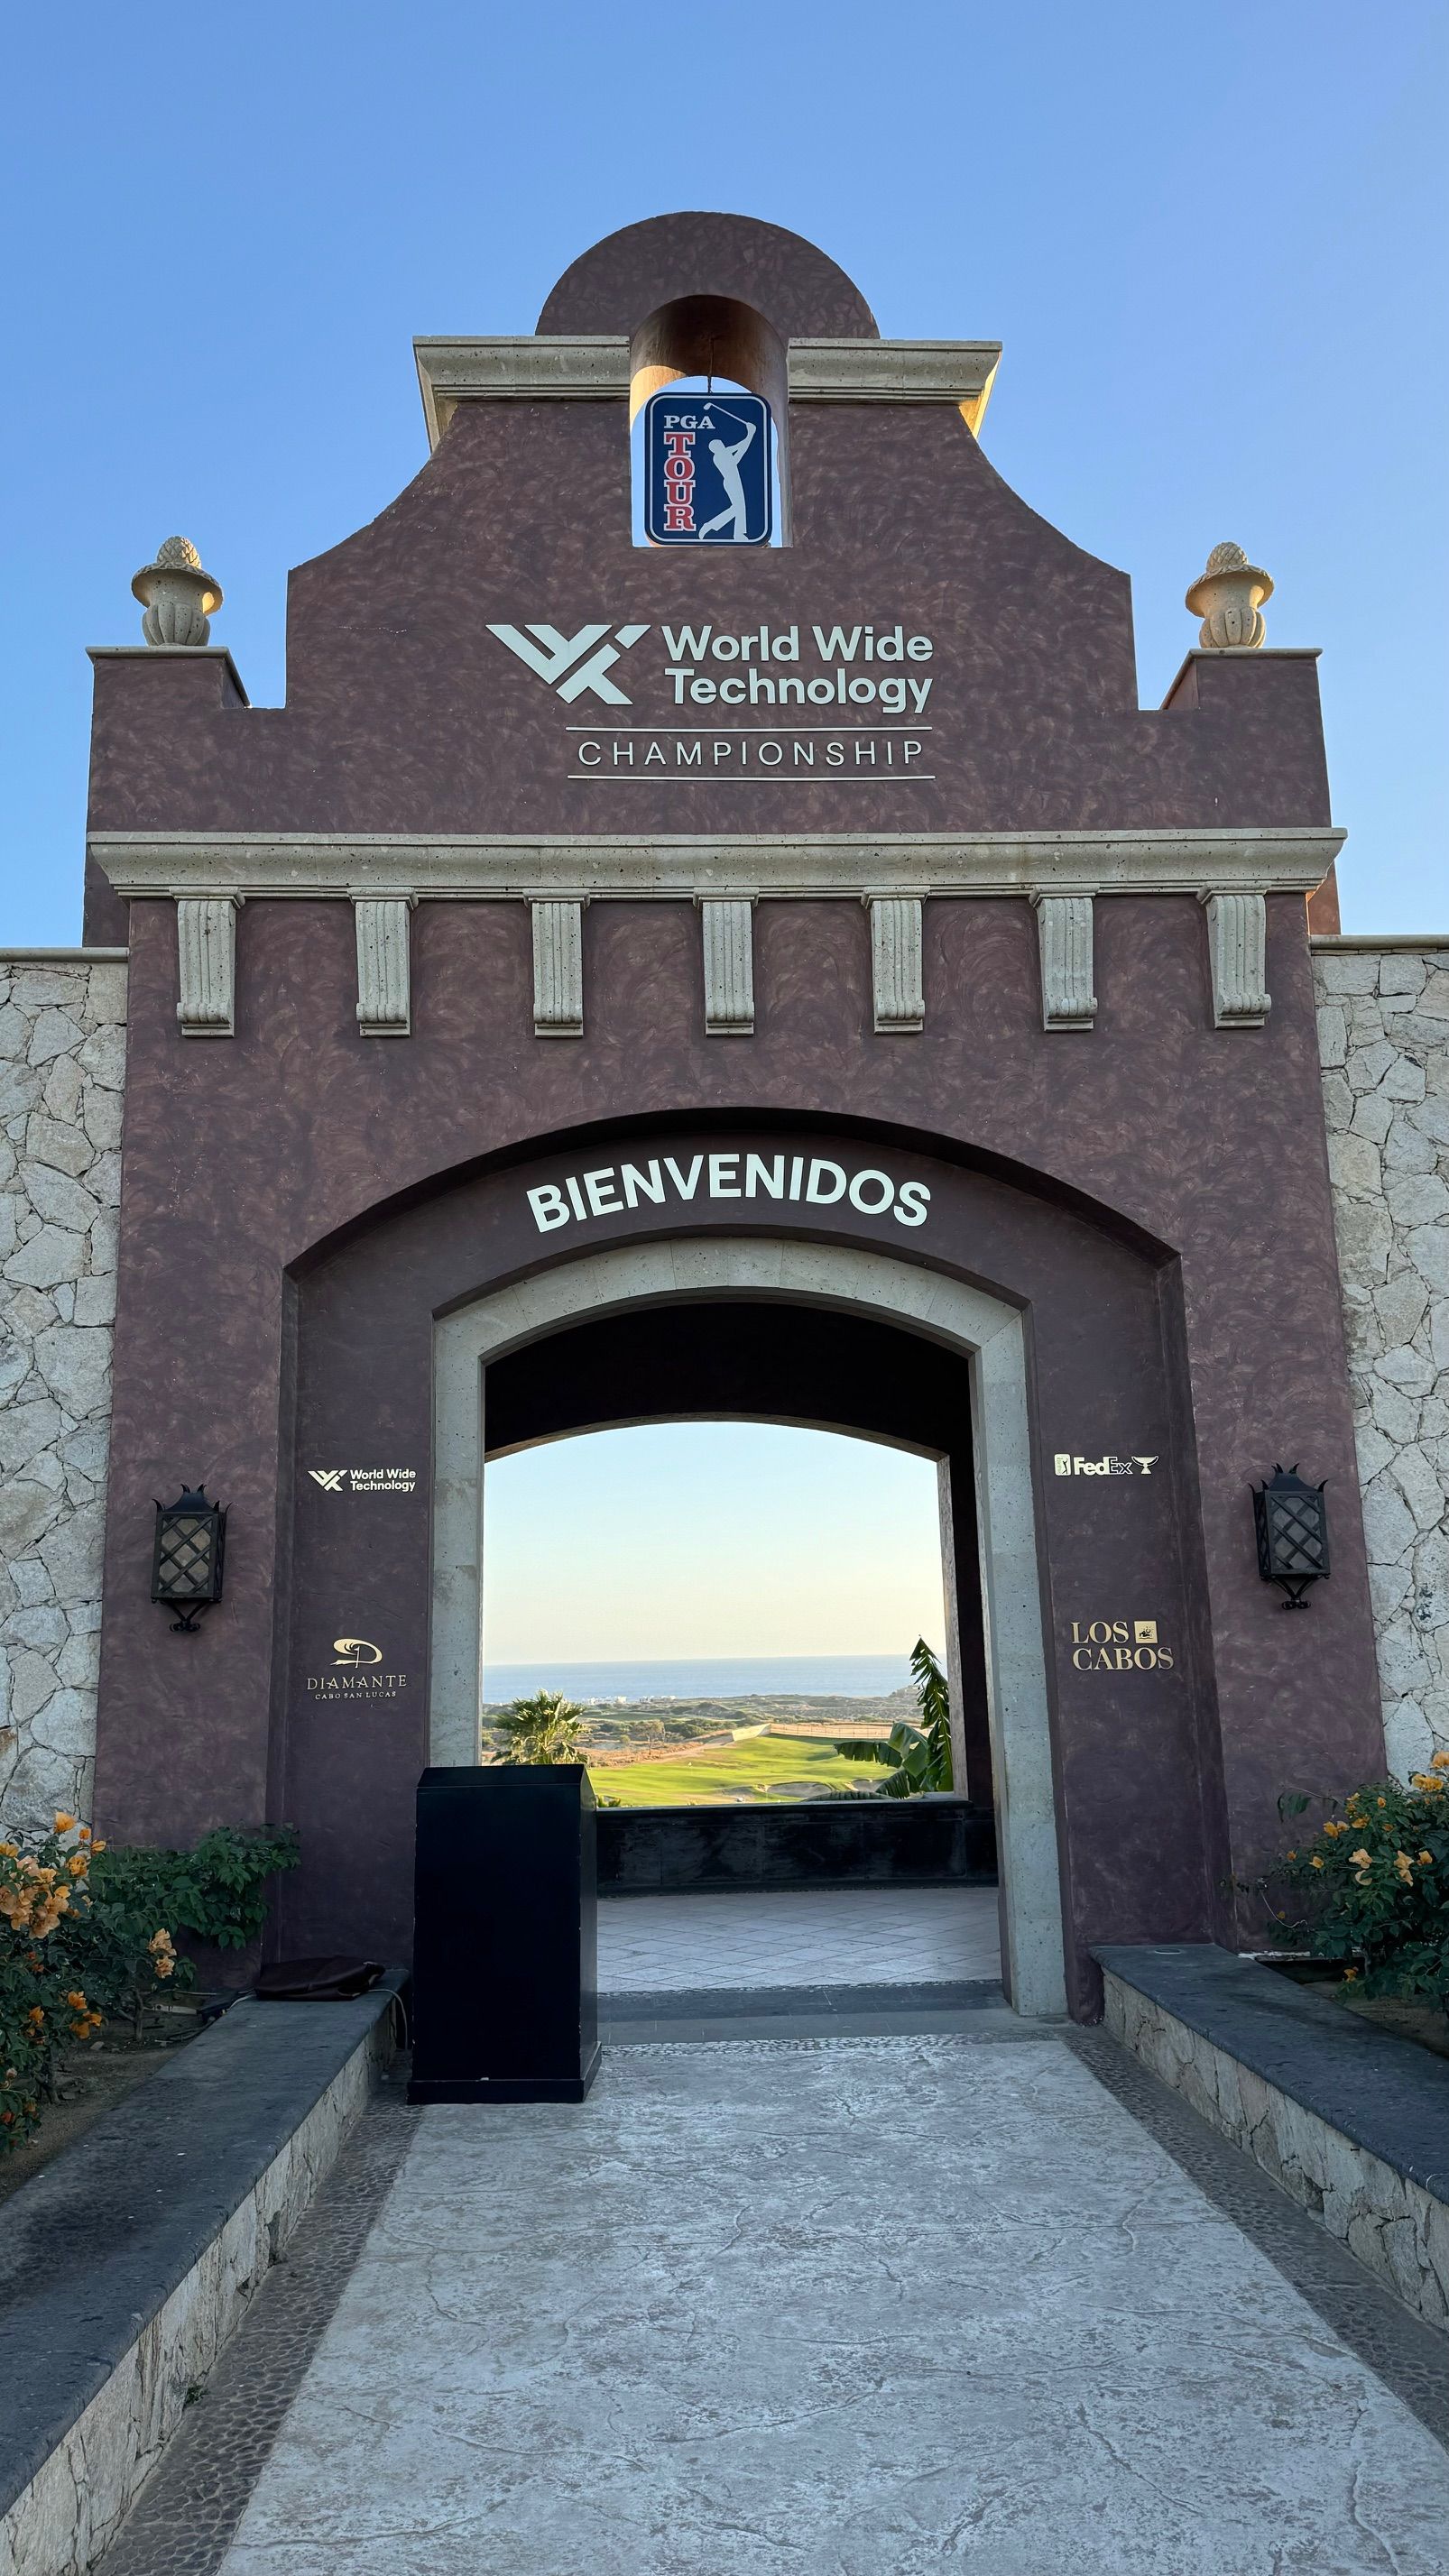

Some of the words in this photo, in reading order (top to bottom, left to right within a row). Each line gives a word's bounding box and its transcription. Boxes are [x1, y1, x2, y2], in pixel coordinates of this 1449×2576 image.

[664, 415, 715, 429] PGA
[663, 431, 697, 532] TOUR
[661, 625, 800, 663] World
[813, 625, 935, 662] Wide
[663, 667, 934, 714] Technology
[577, 740, 925, 767] CHAMPIONSHIP
[525, 1153, 933, 1234] BIENVENIDOS
[350, 1468, 384, 1480] World
[386, 1468, 417, 1479] Wide
[1073, 1456, 1134, 1477] FedEx
[350, 1480, 416, 1493] Technology
[1071, 1621, 1130, 1644] LOS
[1072, 1646, 1175, 1671] CABOS
[307, 1674, 408, 1690] DIAMANTE
[315, 1692, 342, 1700] CABO
[365, 1690, 397, 1698] LUCAS
